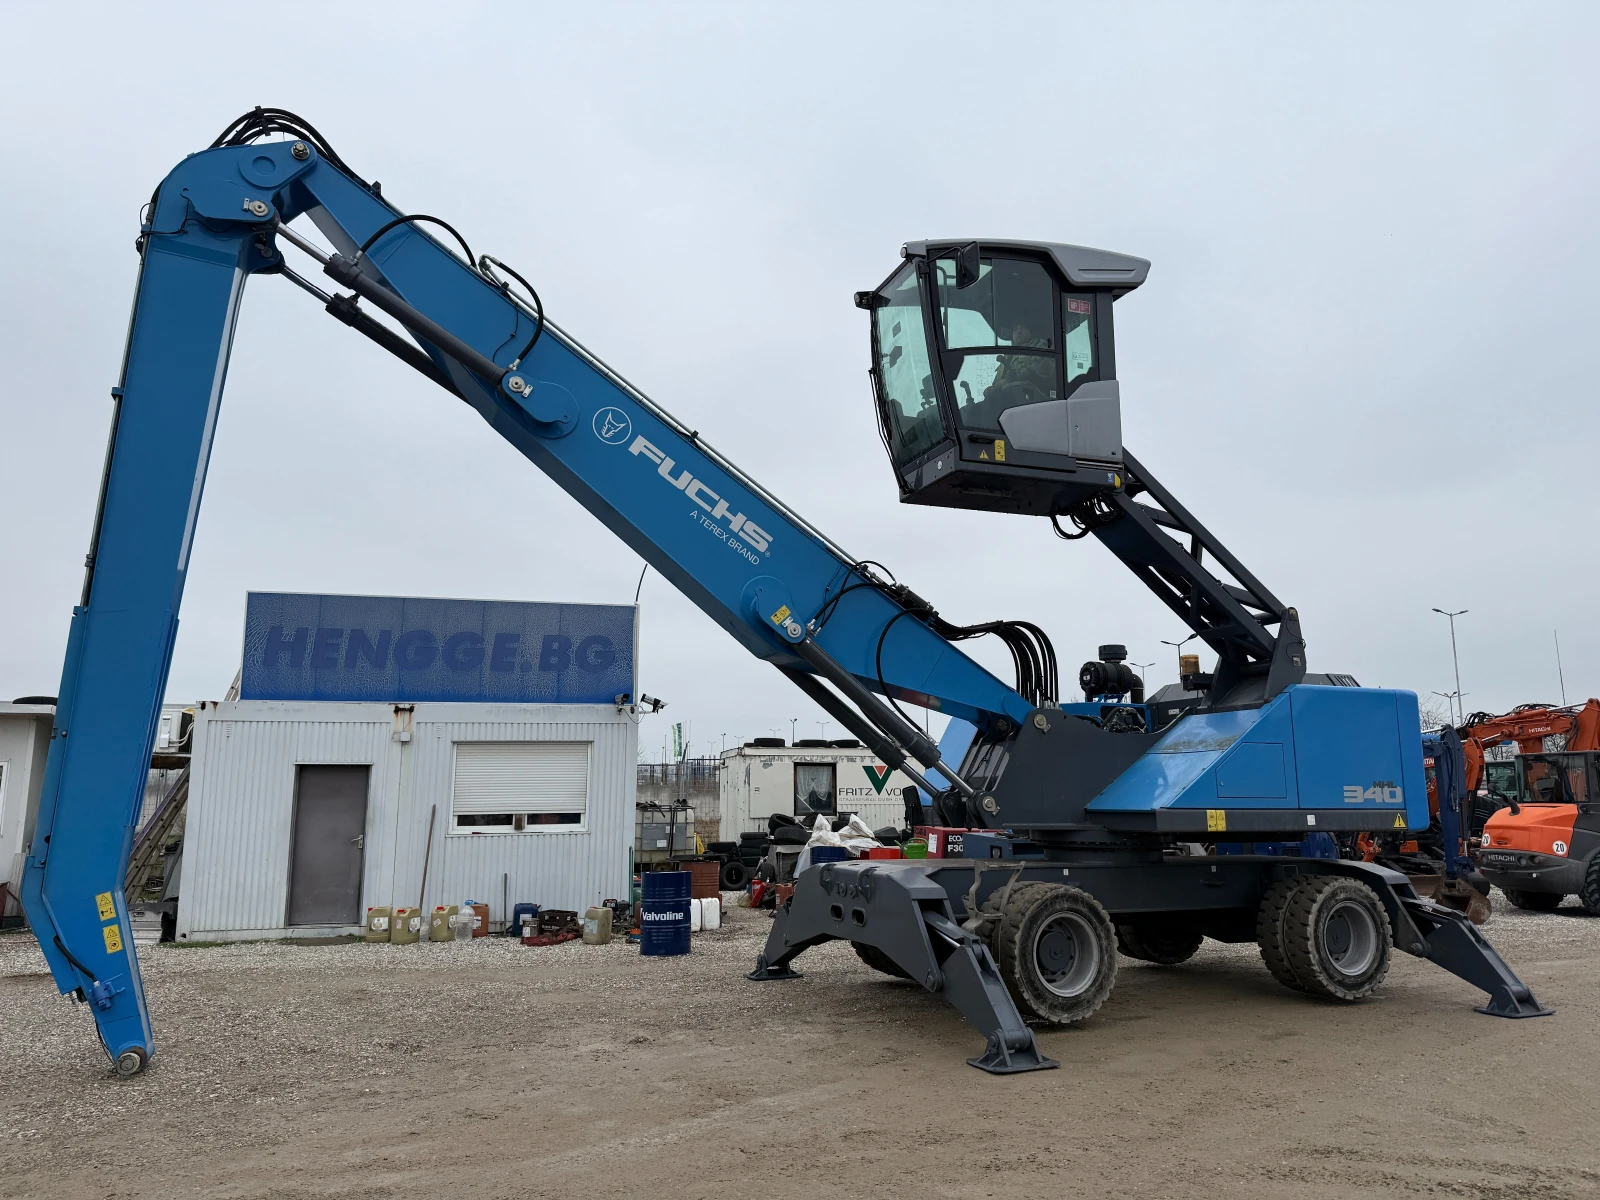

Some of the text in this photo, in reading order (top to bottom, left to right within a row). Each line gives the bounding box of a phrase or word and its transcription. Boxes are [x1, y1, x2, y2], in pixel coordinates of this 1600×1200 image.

[628, 435, 773, 553] FUCHS
[690, 510, 760, 565] A TEREX BRAND
[263, 626, 616, 673] HENGGE.BG
[1528, 726, 1551, 734] HITACHI
[838, 788, 902, 796] FRITZ VO
[1343, 785, 1403, 803] 340
[1555, 843, 1565, 853] 20
[1488, 854, 1515, 862] HITACHI
[642, 911, 684, 921] Valvoline
